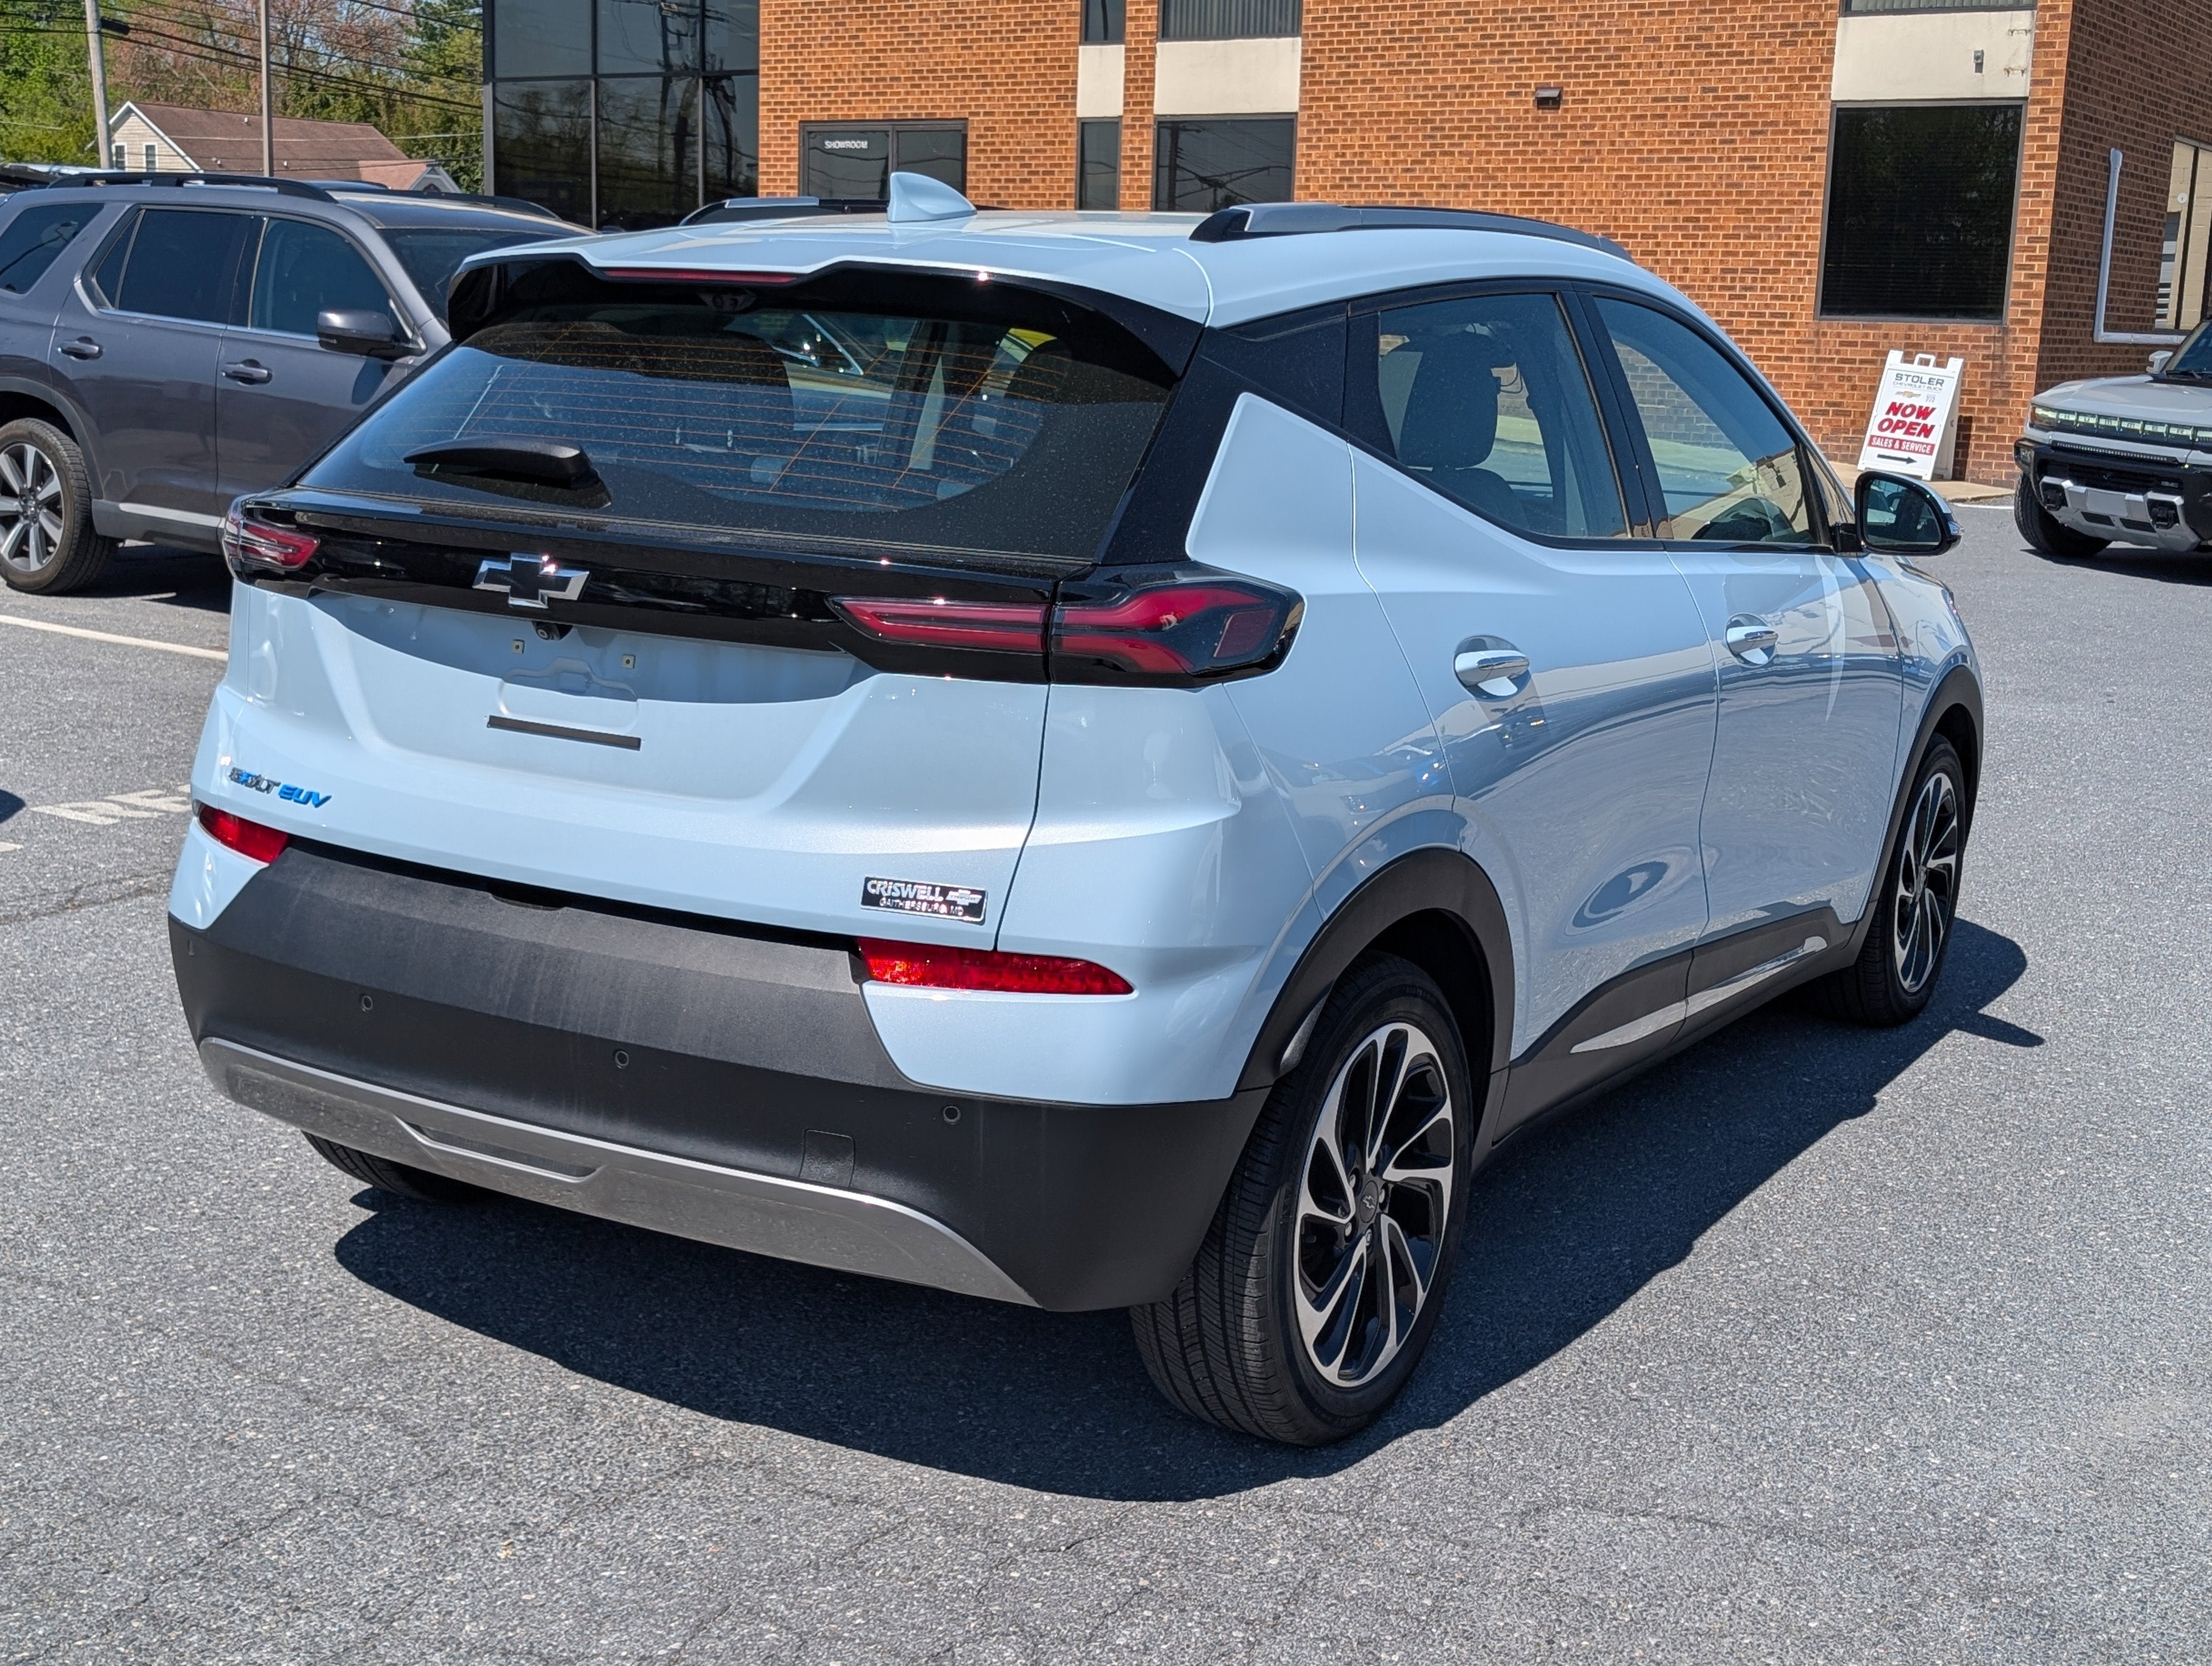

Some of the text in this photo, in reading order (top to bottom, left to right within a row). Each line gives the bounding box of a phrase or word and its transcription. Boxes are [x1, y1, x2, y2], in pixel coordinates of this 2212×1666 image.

[824, 140, 868, 149] SHOWROOM
[1893, 381, 1925, 389] CHEVROLET
[1895, 373, 1945, 387] STOLER
[1885, 401, 1937, 420] NOW
[1877, 418, 1935, 438] OPEN
[1872, 438, 1932, 454] SALES & SERVICE
[278, 784, 332, 808] EUV
[867, 880, 944, 902] CRISWELL
[950, 905, 964, 916] MD
